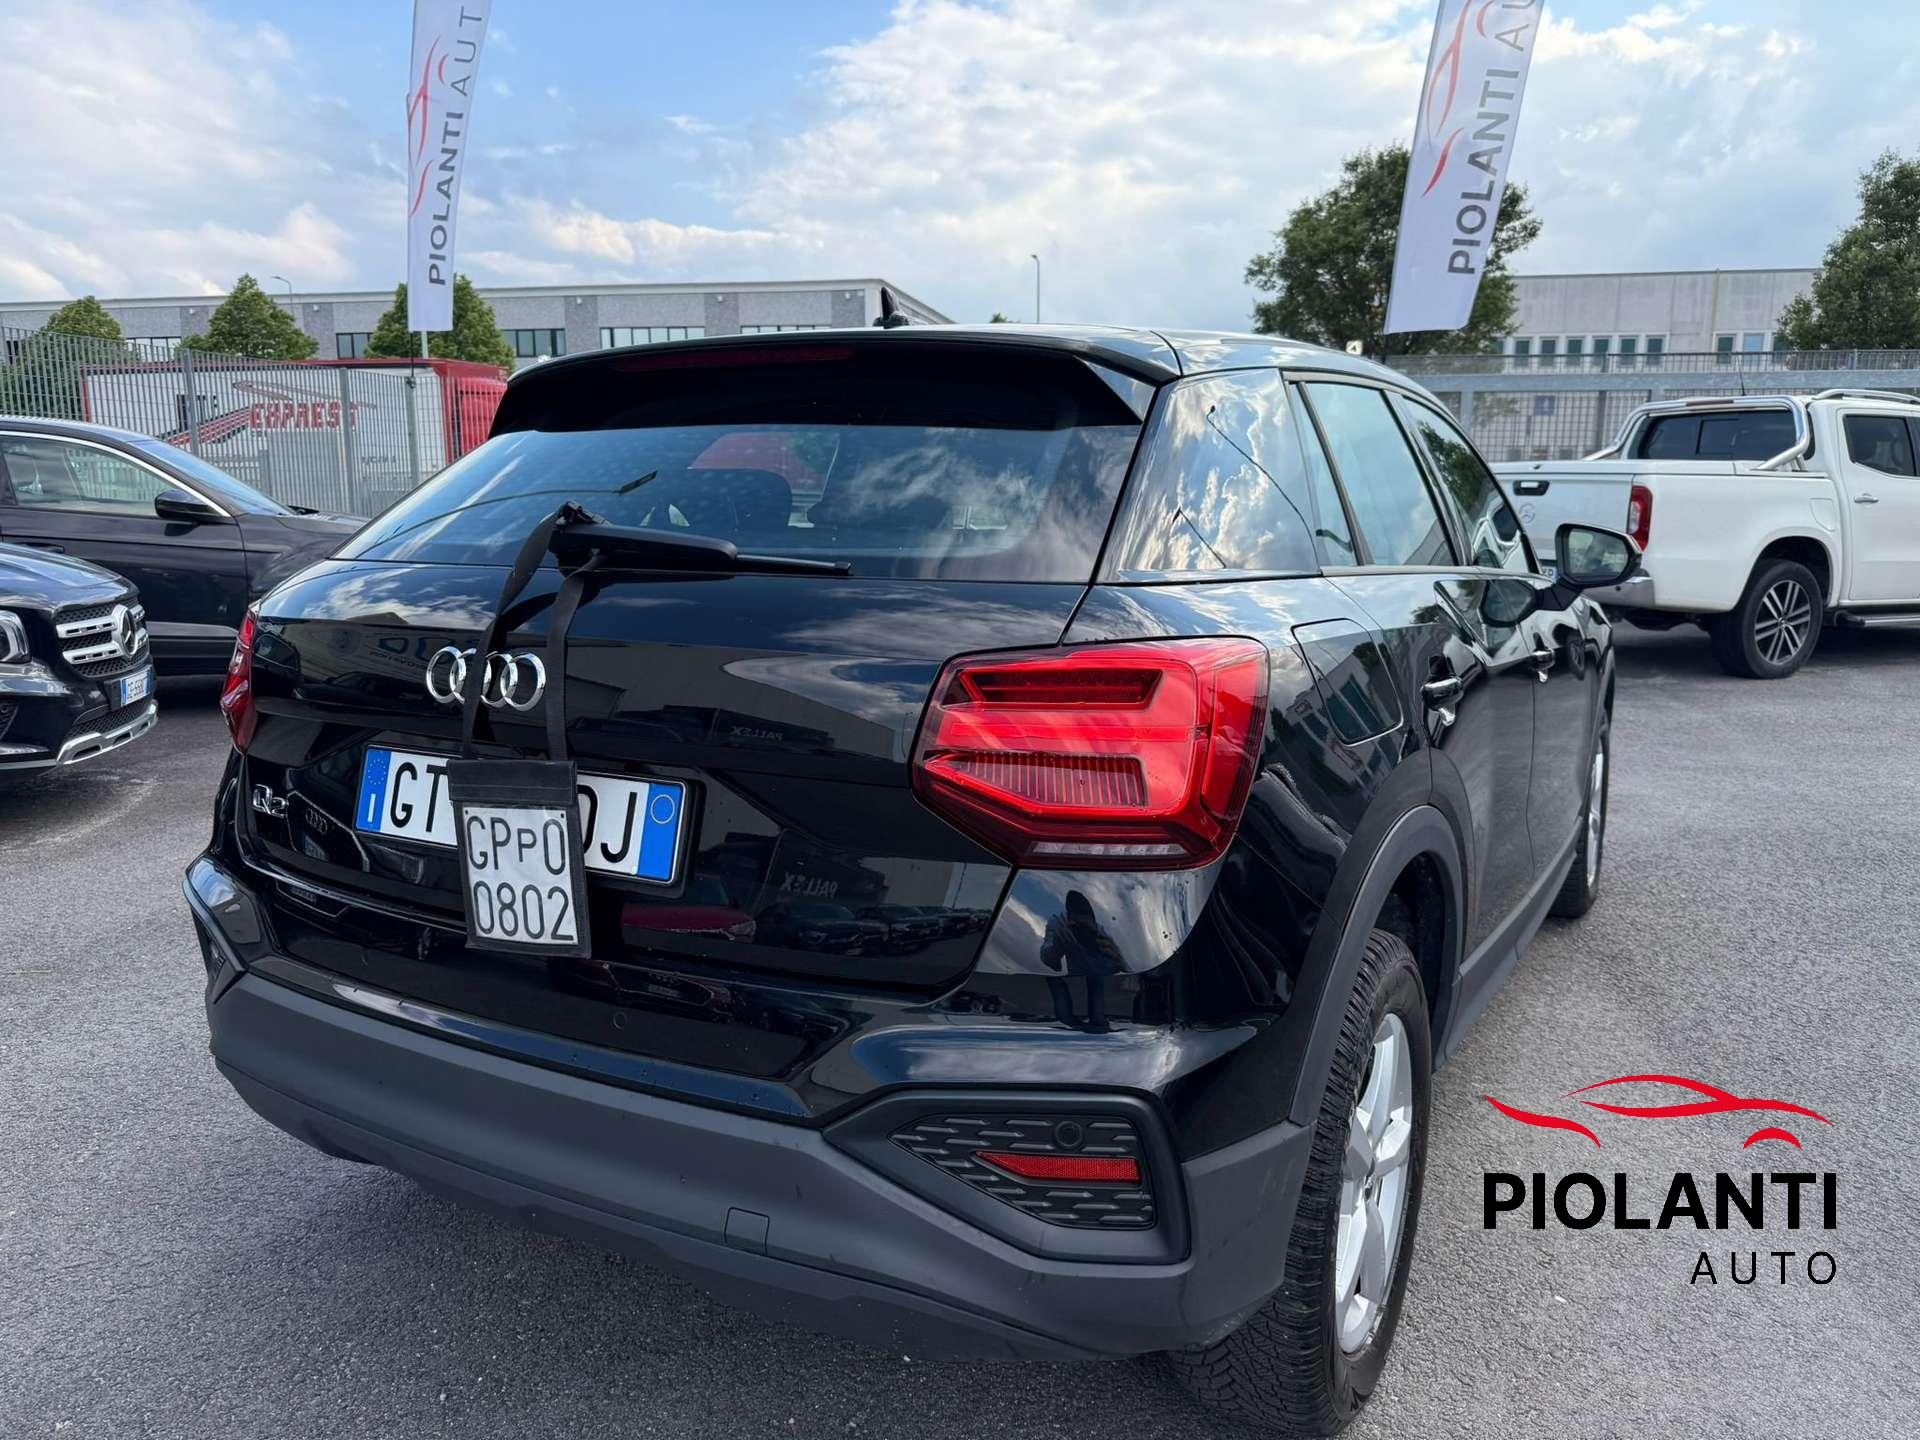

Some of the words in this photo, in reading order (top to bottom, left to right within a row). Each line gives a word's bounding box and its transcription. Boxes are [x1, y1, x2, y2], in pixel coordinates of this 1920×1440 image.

[428, 111, 464, 286] PIOLANTI
[1447, 68, 1521, 275] PIOLANTI
[252, 783, 290, 819] Q2
[472, 880, 575, 942] 0802
